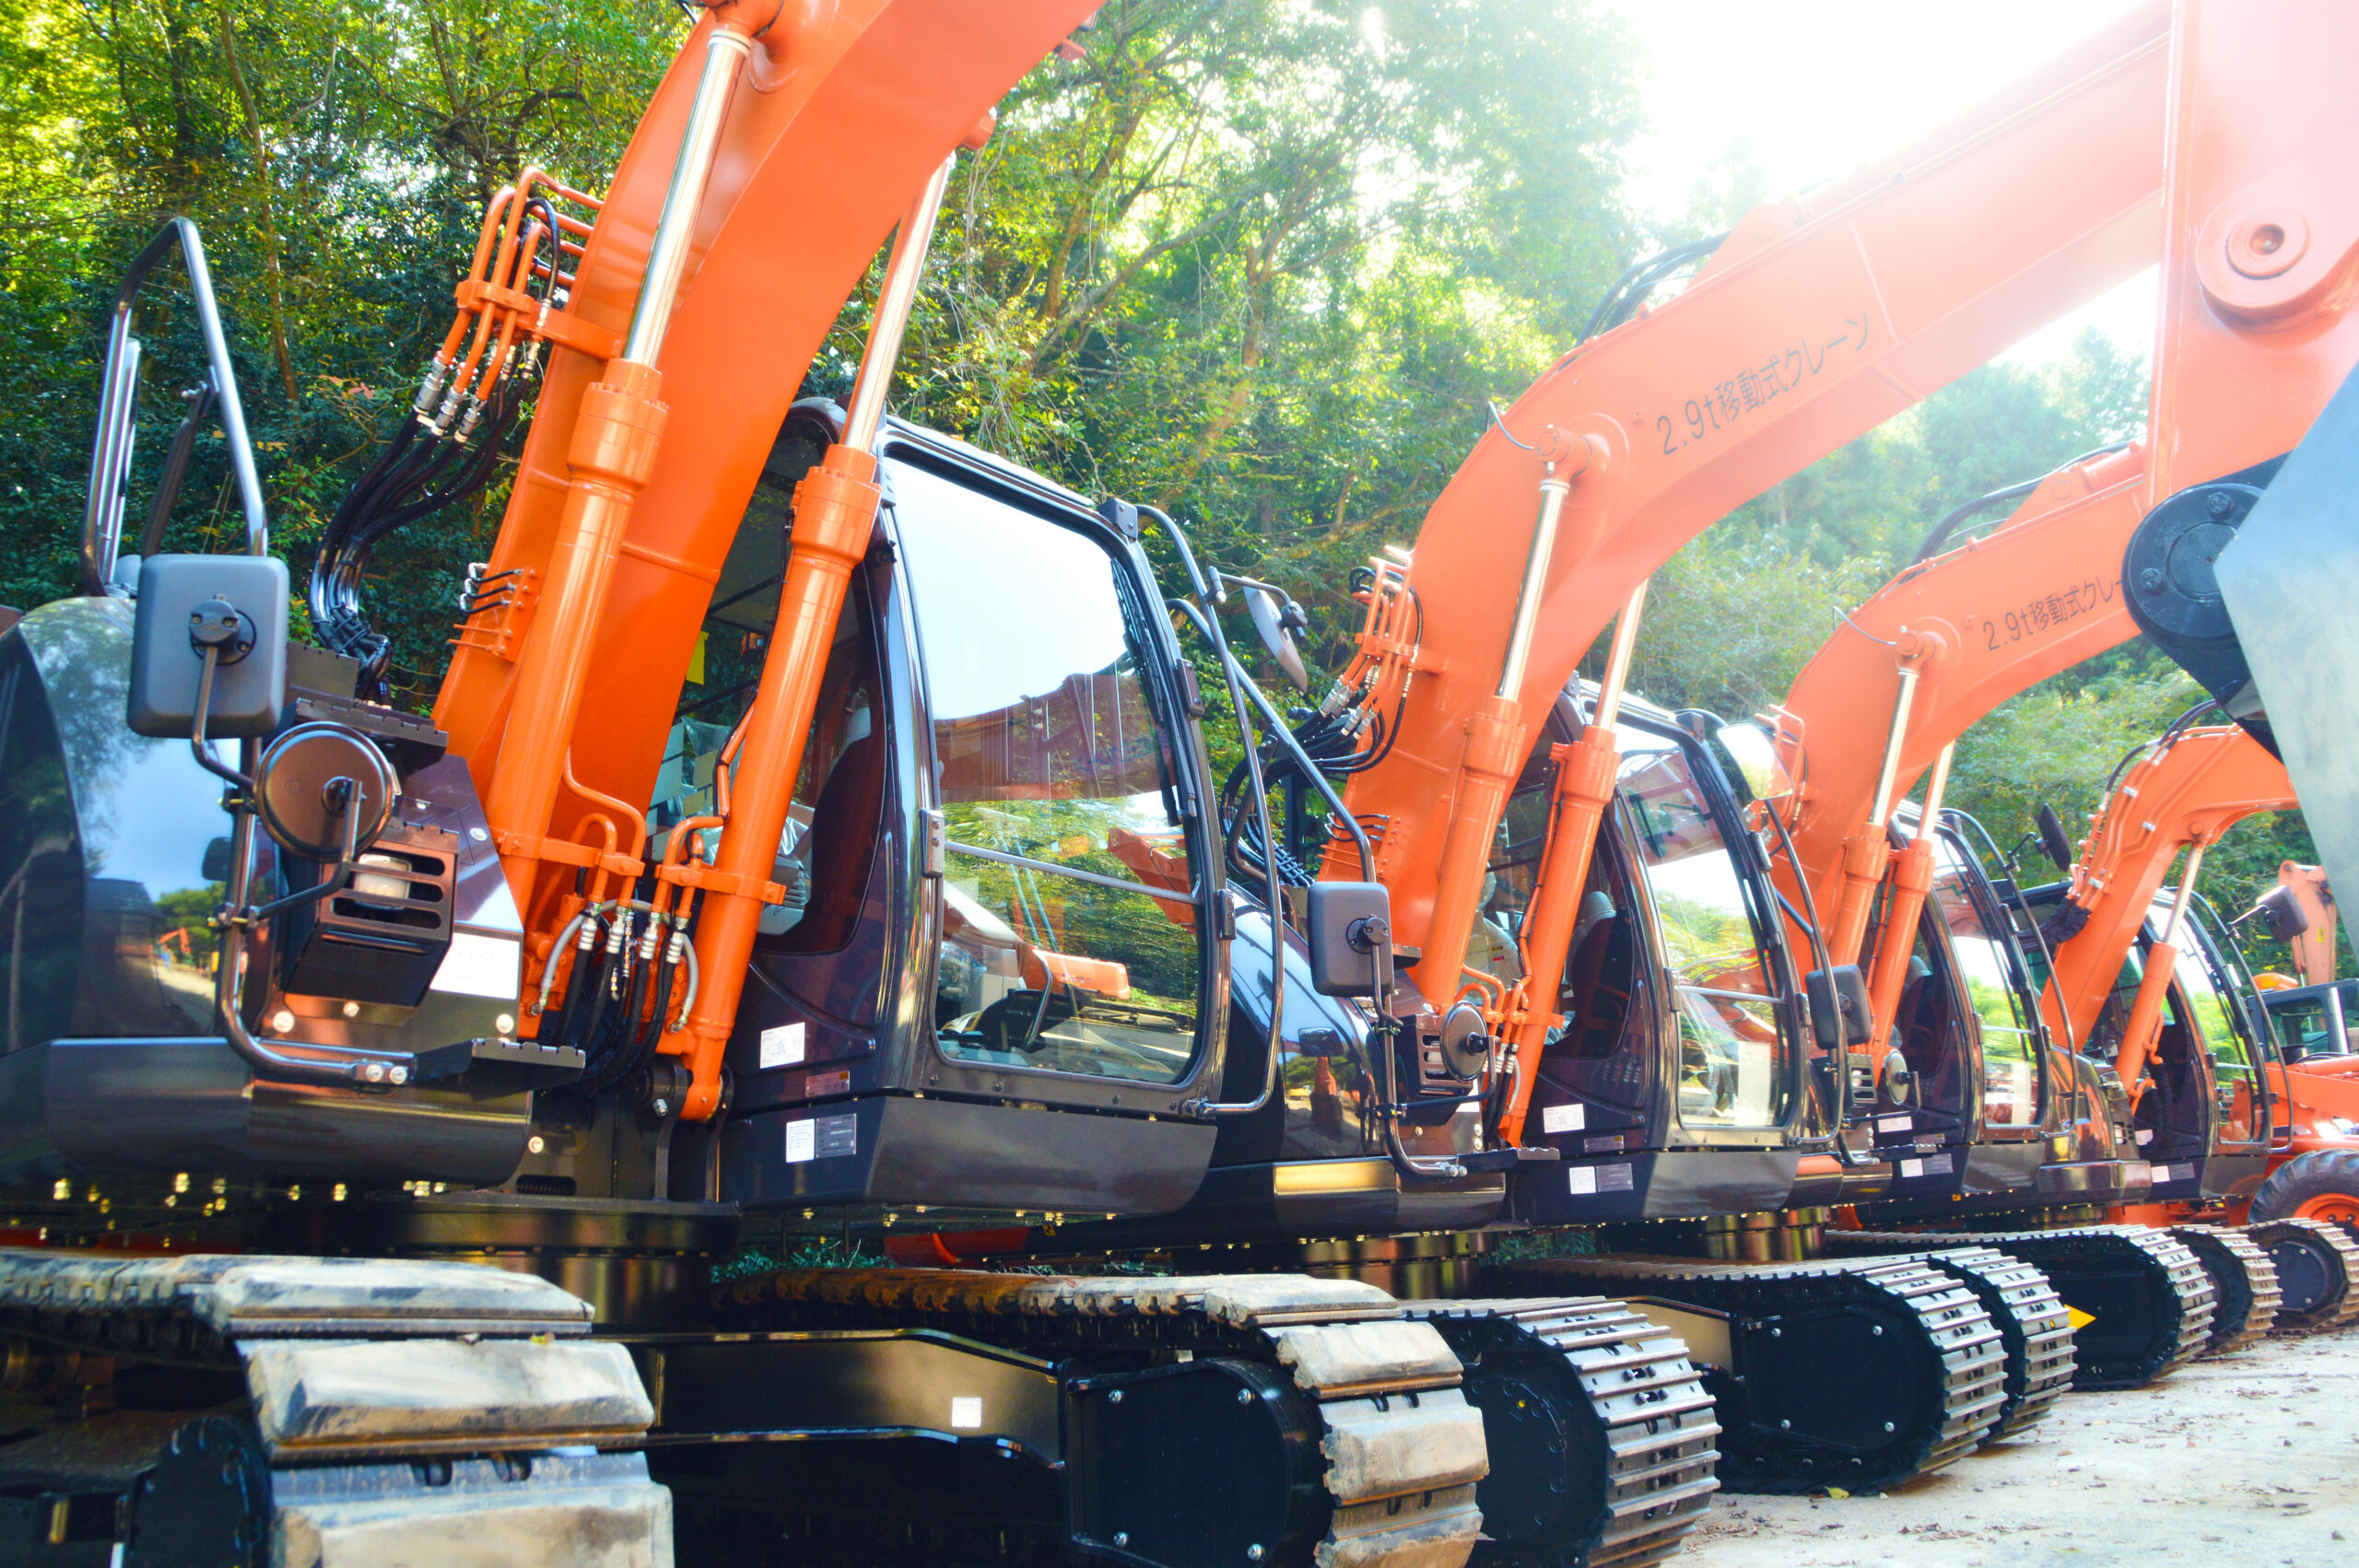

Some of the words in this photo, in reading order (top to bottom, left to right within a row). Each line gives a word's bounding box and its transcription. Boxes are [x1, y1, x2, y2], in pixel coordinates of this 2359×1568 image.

[1657, 312, 1869, 456] 2.9t移動式クレーン
